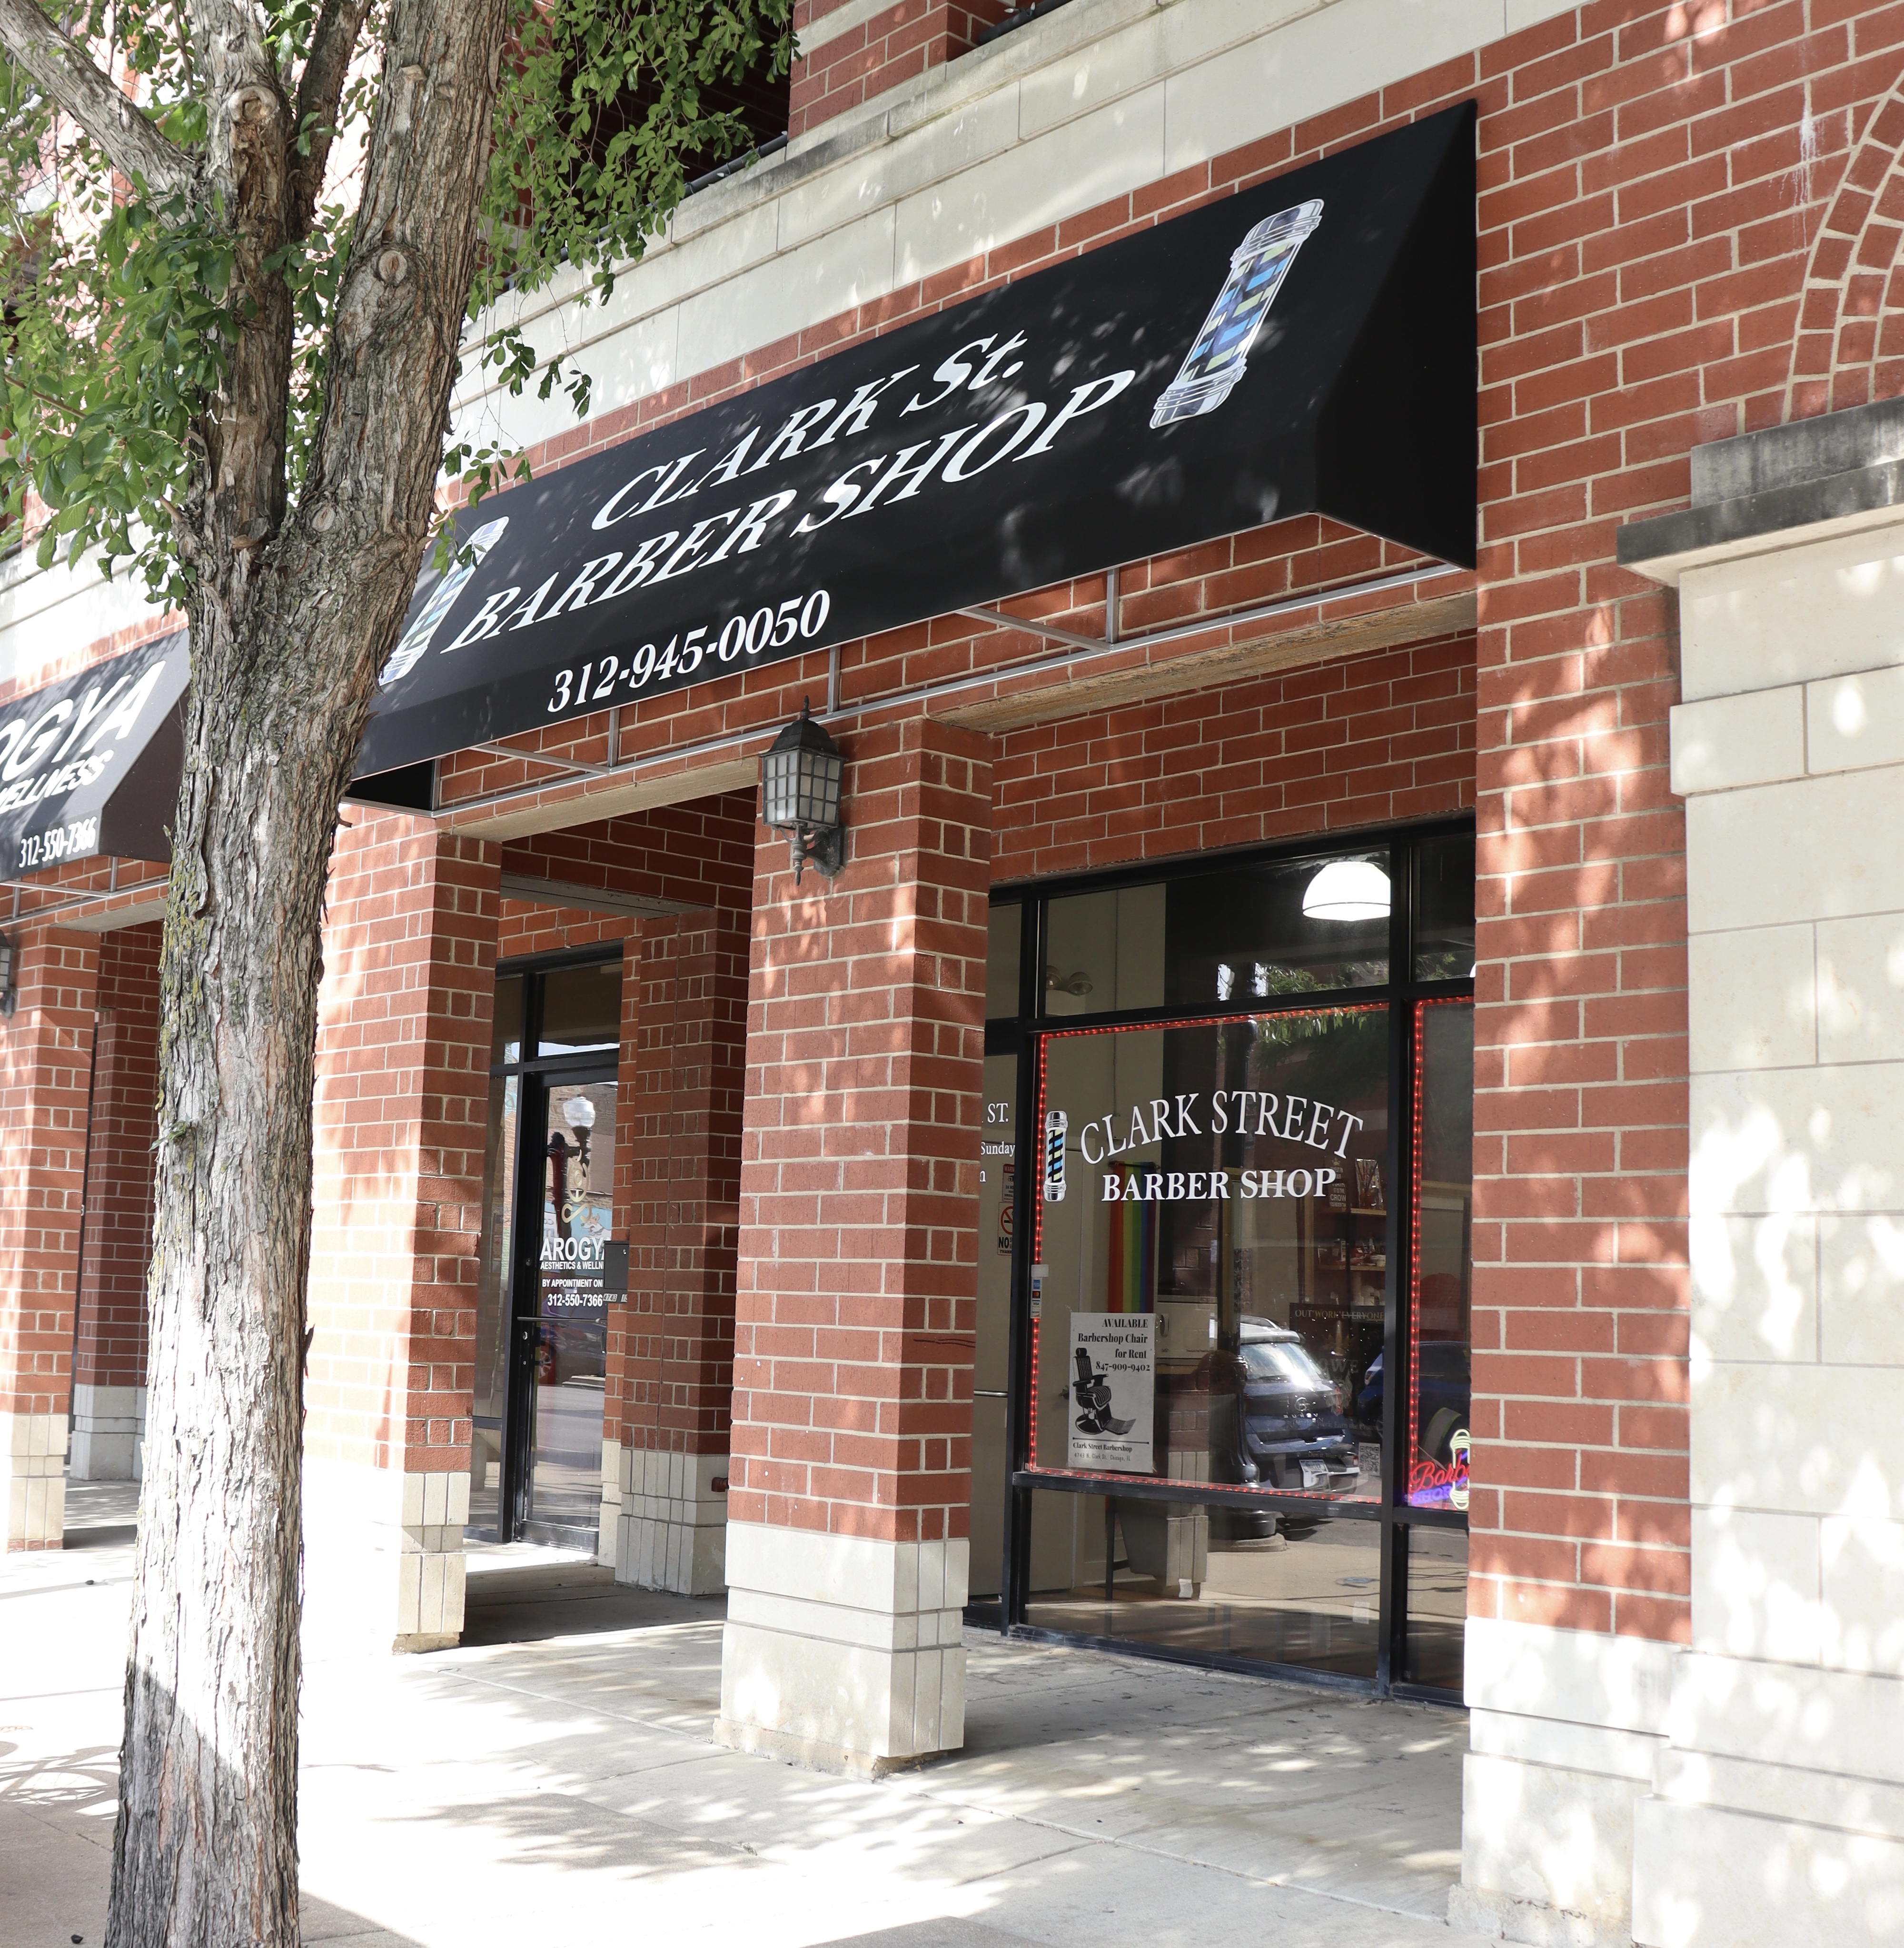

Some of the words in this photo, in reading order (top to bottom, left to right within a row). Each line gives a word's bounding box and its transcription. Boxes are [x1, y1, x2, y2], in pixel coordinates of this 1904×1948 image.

[592, 364, 920, 529] CLARK
[899, 330, 1027, 417] St.
[440, 489, 797, 654] BARBER
[789, 370, 1135, 537] SHOP
[548, 590, 829, 712] 312-945-0050
[0, 749, 114, 814] ELLNESS
[19, 816, 97, 867] 312-550-7366
[987, 1103, 1008, 1123] ST.
[1081, 1093, 1201, 1163] CLARK
[1212, 1091, 1363, 1158] STREET
[981, 1141, 1015, 1157] Sunday
[1101, 1172, 1230, 1201] BARBER
[1241, 1169, 1336, 1198] SHOP
[999, 1237, 1009, 1248] NO
[540, 1262, 575, 1270] AESTHETICS
[577, 1261, 581, 1270] &
[582, 1262, 604, 1270] WELLN
[542, 1279, 550, 1287] BY
[551, 1279, 593, 1287] APPOINTMENT
[593, 1279, 604, 1287] ON
[547, 1294, 603, 1307] 312-550-7366
[1102, 1319, 1148, 1328] AVAILABLE
[1078, 1333, 1123, 1344] Barbershop
[1125, 1334, 1148, 1343] Chair
[1115, 1349, 1127, 1358] for
[1129, 1350, 1147, 1359] Rent
[1096, 1361, 1150, 1372] 847-909-9402
[1103, 1444, 1132, 1453] Barbershop
